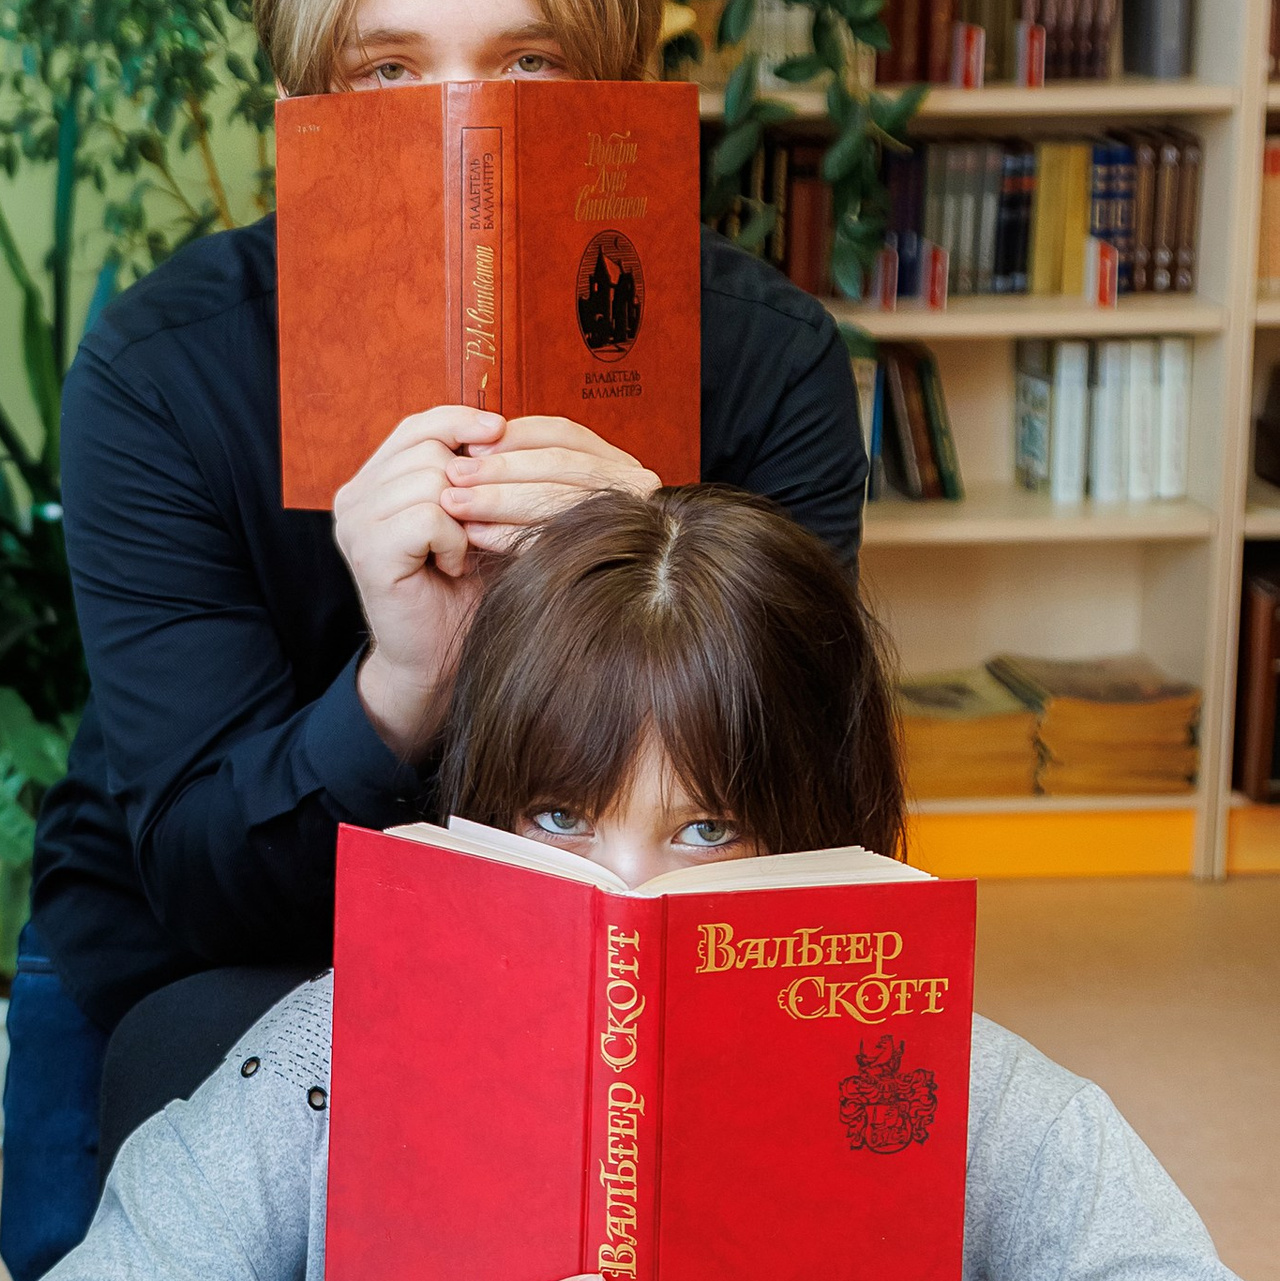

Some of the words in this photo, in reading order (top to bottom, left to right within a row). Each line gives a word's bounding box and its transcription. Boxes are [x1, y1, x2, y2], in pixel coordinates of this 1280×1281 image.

[469, 158, 481, 231] ВЛАДЕТЕЛЬ
[483, 152, 494, 231] БАЛЛАНТРЭ
[581, 384, 643, 400] БАЛЛАНТРЭ
[584, 370, 641, 385] ВЛАДЕТЕЛЬ
